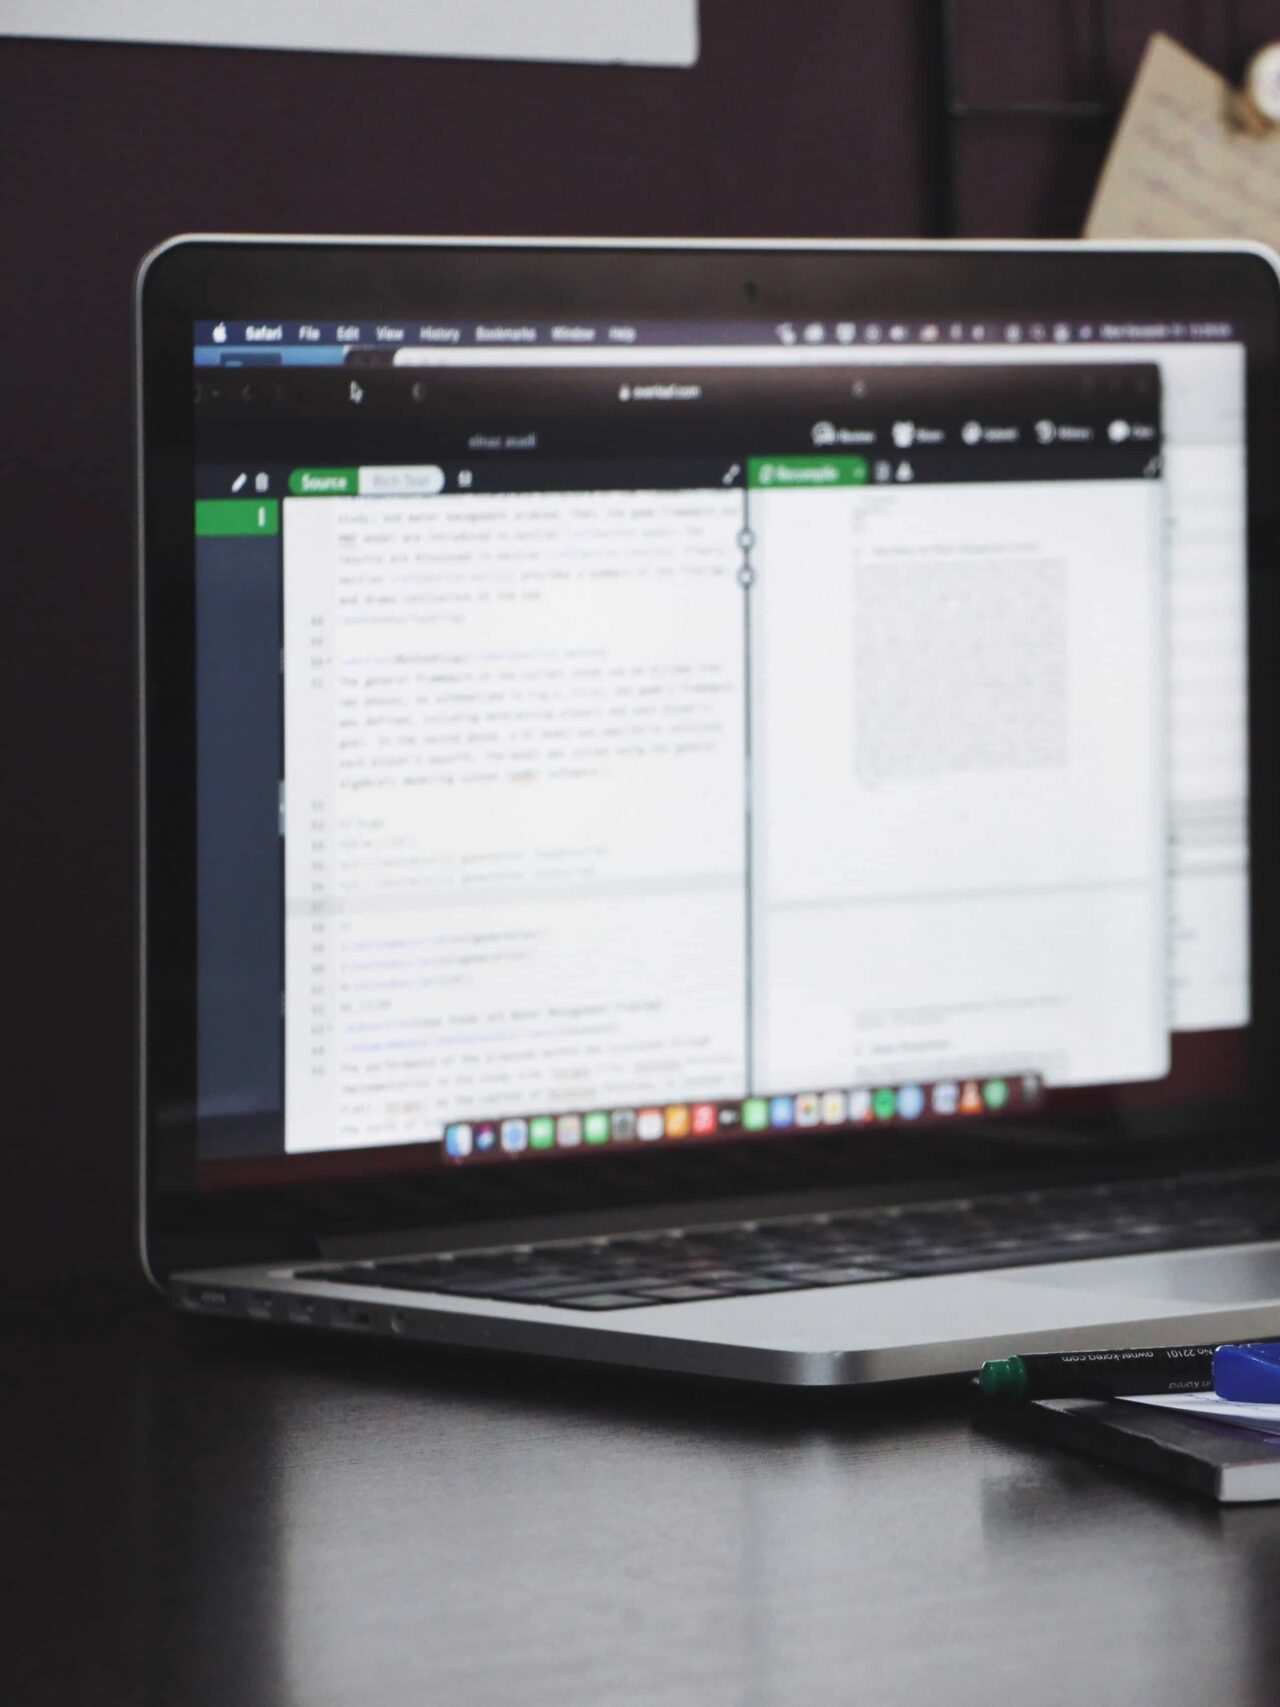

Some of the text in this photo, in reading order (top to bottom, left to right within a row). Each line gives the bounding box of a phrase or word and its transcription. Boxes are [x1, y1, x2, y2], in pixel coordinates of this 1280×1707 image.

[245, 325, 283, 342] Safari
[299, 326, 321, 341] File
[336, 326, 360, 342] Edit
[376, 326, 404, 342] View
[420, 326, 460, 343] History
[475, 326, 537, 342] Bookmarks
[551, 326, 597, 342] Window
[302, 473, 347, 491] Source
[1061, 1351, 1154, 1363] owner-korea.com
